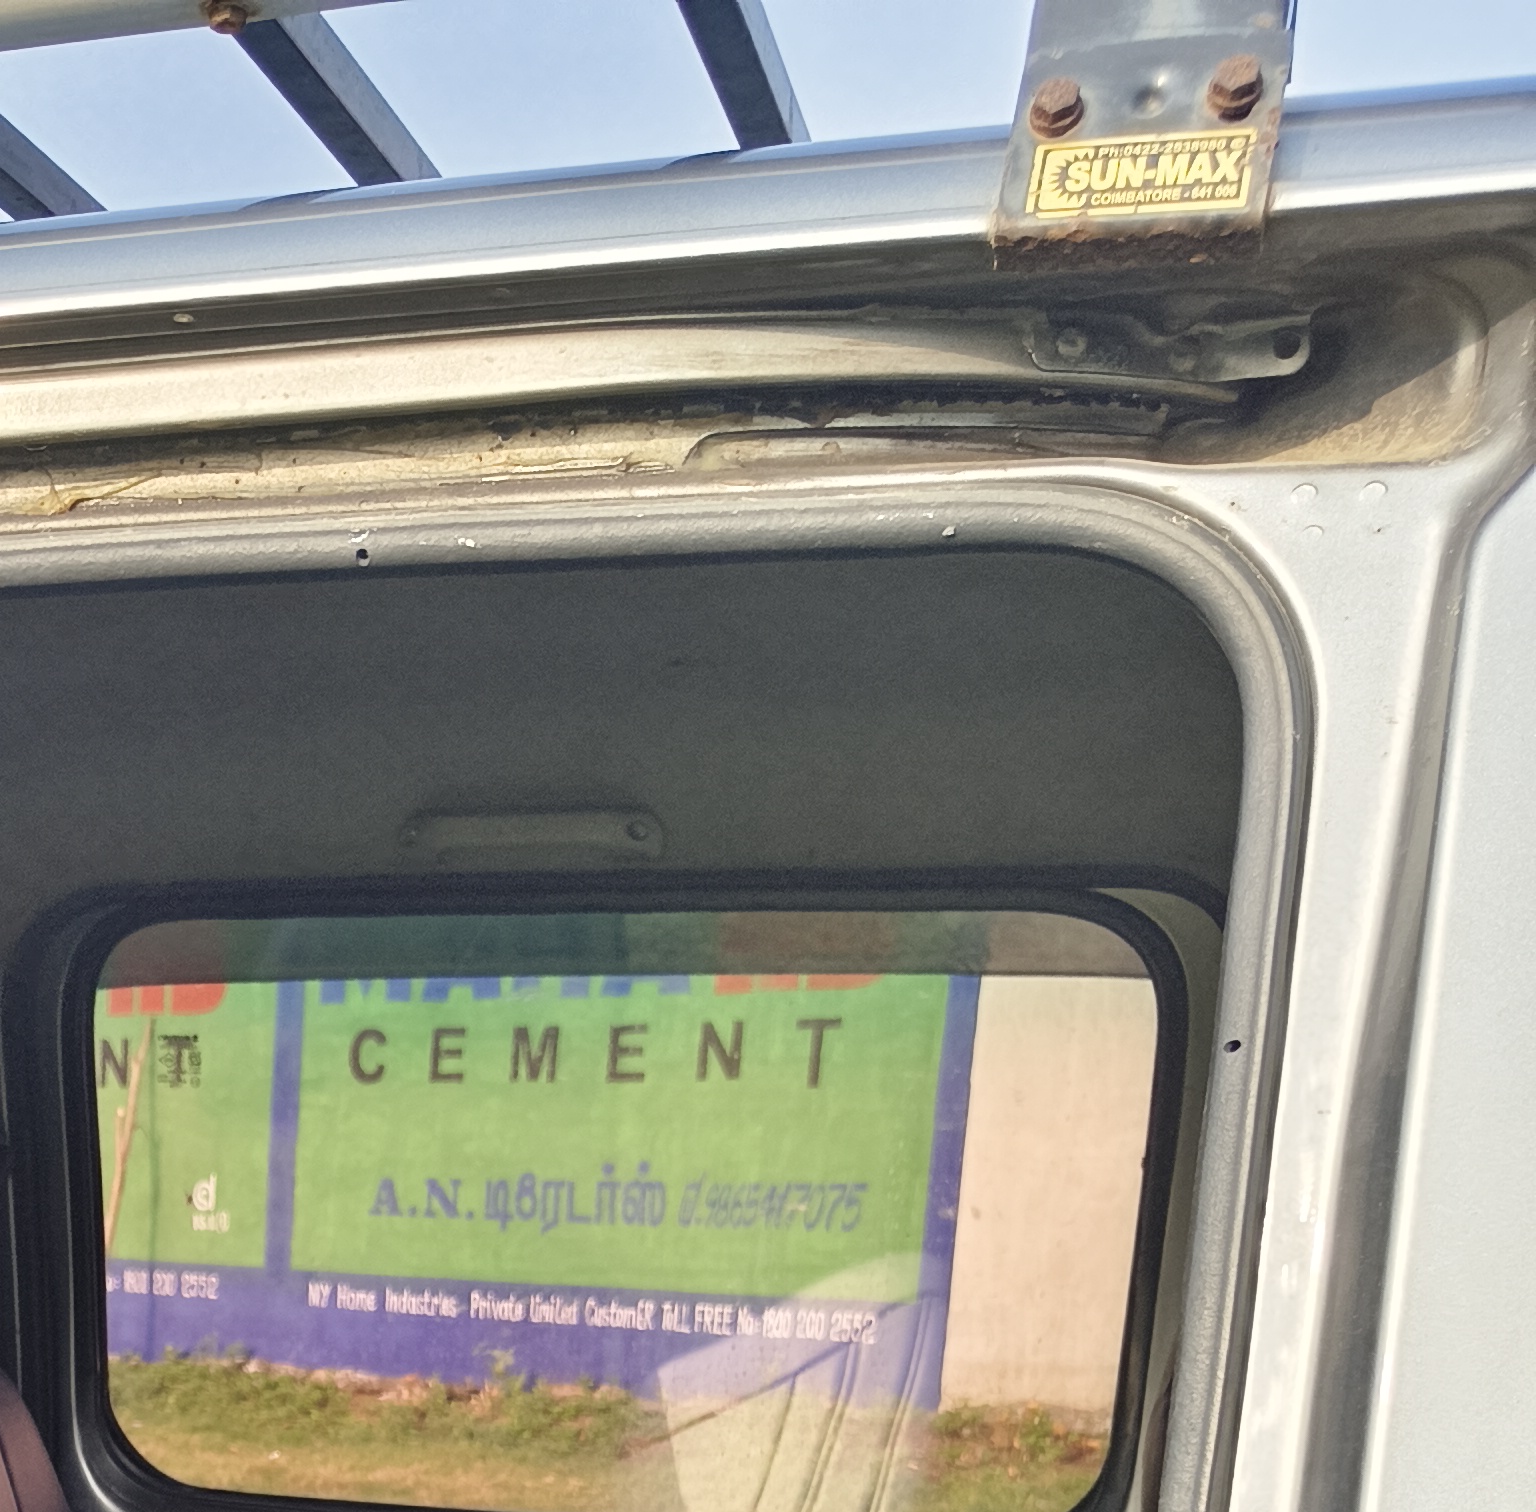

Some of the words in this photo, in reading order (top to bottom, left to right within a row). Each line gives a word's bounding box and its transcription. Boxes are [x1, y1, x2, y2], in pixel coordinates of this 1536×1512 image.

[1065, 151, 1243, 192] SUN-MAX
[1091, 187, 1181, 205] COIMBATORE
[348, 1016, 843, 1089] CEMENT
[336, 1282, 378, 1311] Home
[470, 1290, 525, 1322] Private
[694, 1302, 734, 1336] FREE
[795, 1307, 826, 1340] 200
[830, 1309, 879, 1344] 2552
